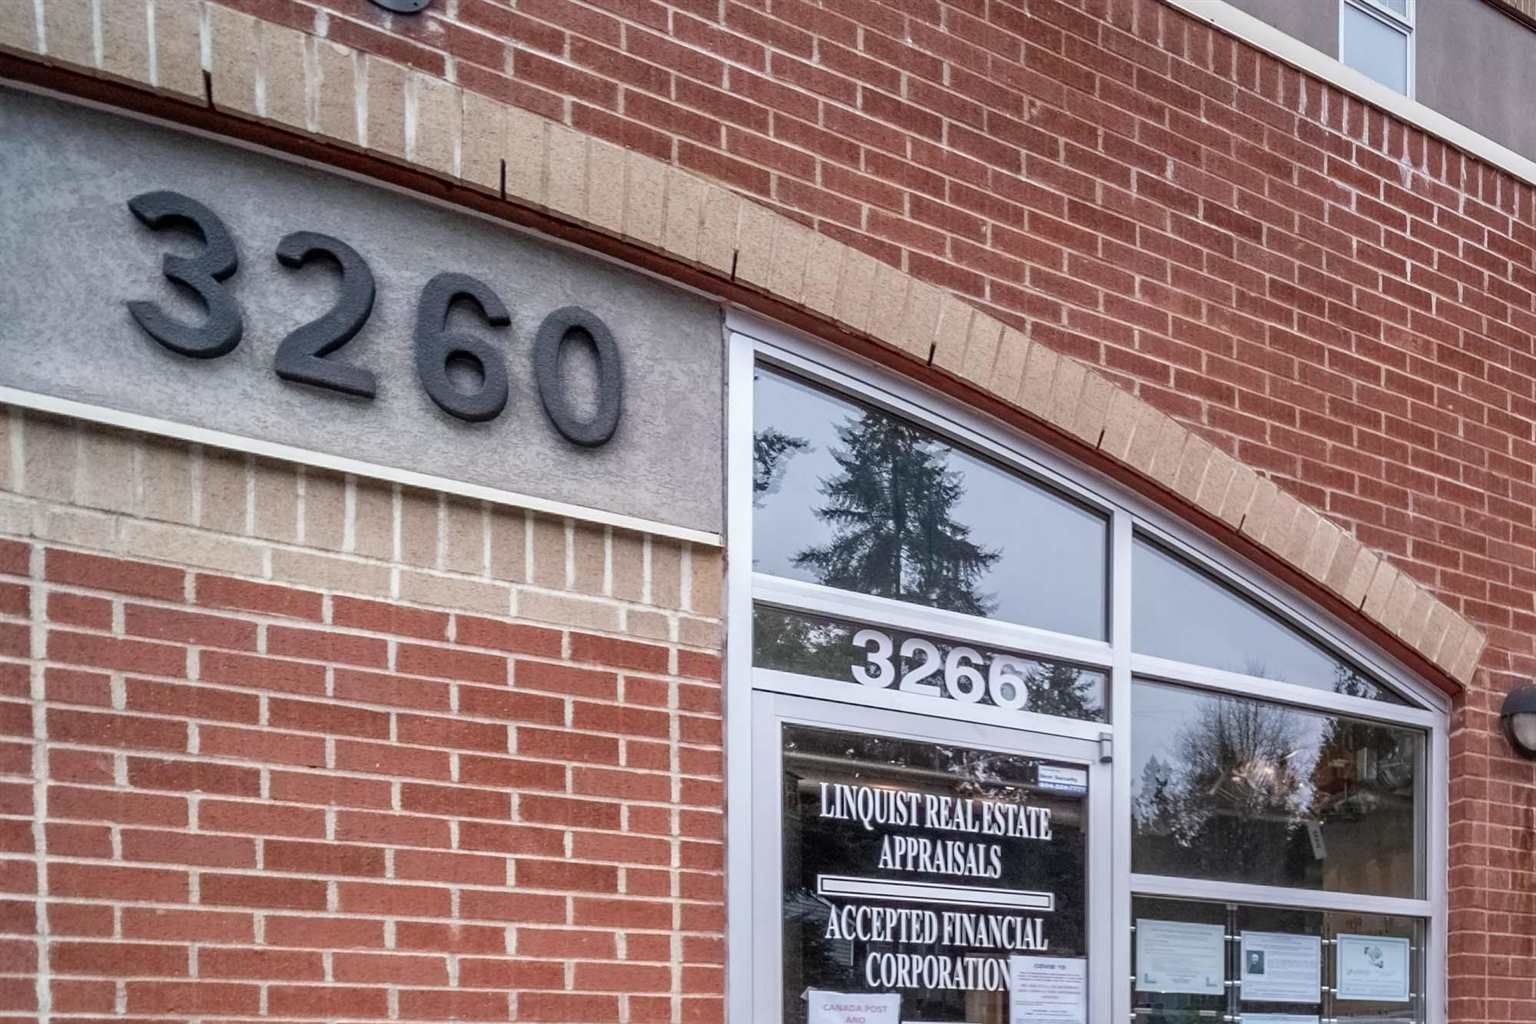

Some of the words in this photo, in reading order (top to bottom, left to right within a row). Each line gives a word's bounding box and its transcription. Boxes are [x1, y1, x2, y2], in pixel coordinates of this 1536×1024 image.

[127, 190, 624, 448] 3260
[851, 629, 1029, 711] 3266
[819, 782, 922, 830] LINQUIST
[925, 794, 979, 833] REAL
[982, 801, 1052, 840] ESTATE
[878, 834, 1001, 878] APPRAISALS
[825, 904, 938, 944] ACCEPTED
[942, 911, 1048, 950] FINANCIAL
[865, 952, 1011, 991] CORPORATION
[823, 1003, 862, 1012] CANADA
[865, 1005, 888, 1013] POST
[846, 1016, 866, 1024] AND
